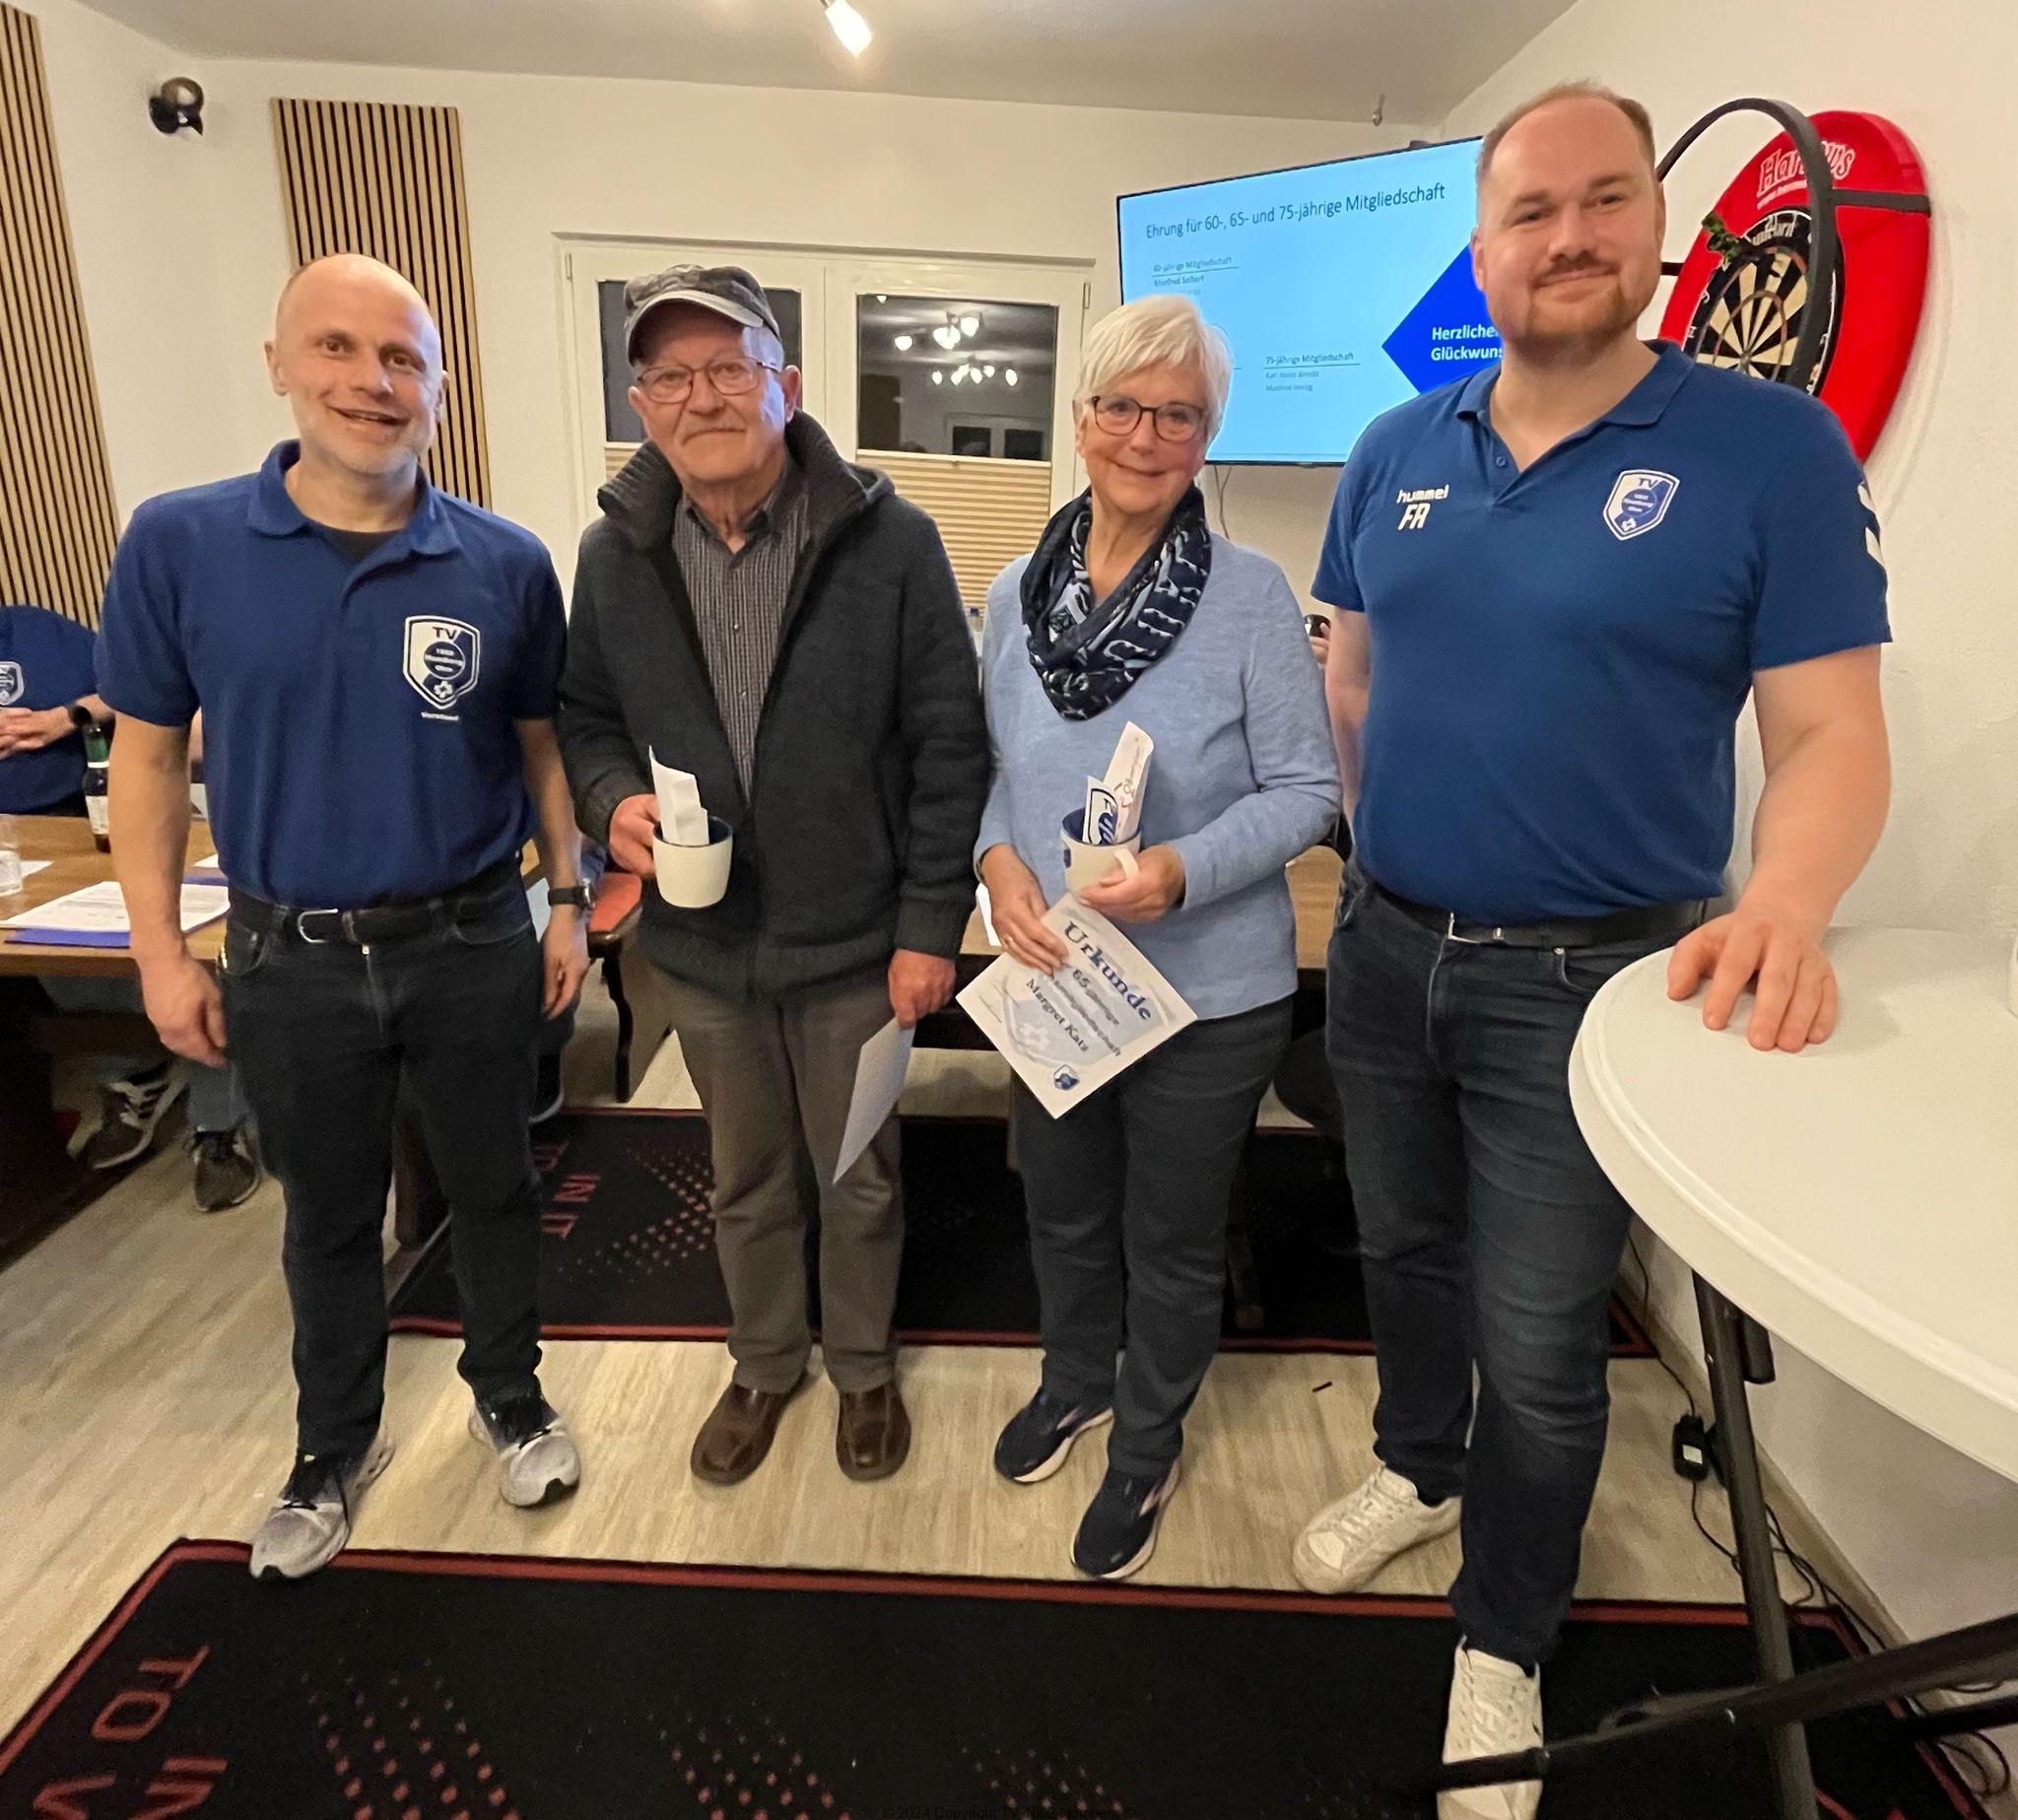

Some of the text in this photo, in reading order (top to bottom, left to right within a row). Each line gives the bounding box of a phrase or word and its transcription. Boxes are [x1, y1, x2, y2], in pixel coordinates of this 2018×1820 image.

[1757, 140, 1855, 198] Harws
[1146, 182, 1446, 238] Ehrung für 60-, 65- und 75-jährige Mitgliedschaft
[1432, 323, 1499, 341] Herzliche
[1396, 484, 1449, 504] hummel
[1639, 477, 1658, 488] TV
[432, 626, 458, 640] TV
[1064, 920, 1151, 1020] Urkunde
[91, 1644, 211, 1741] TO
